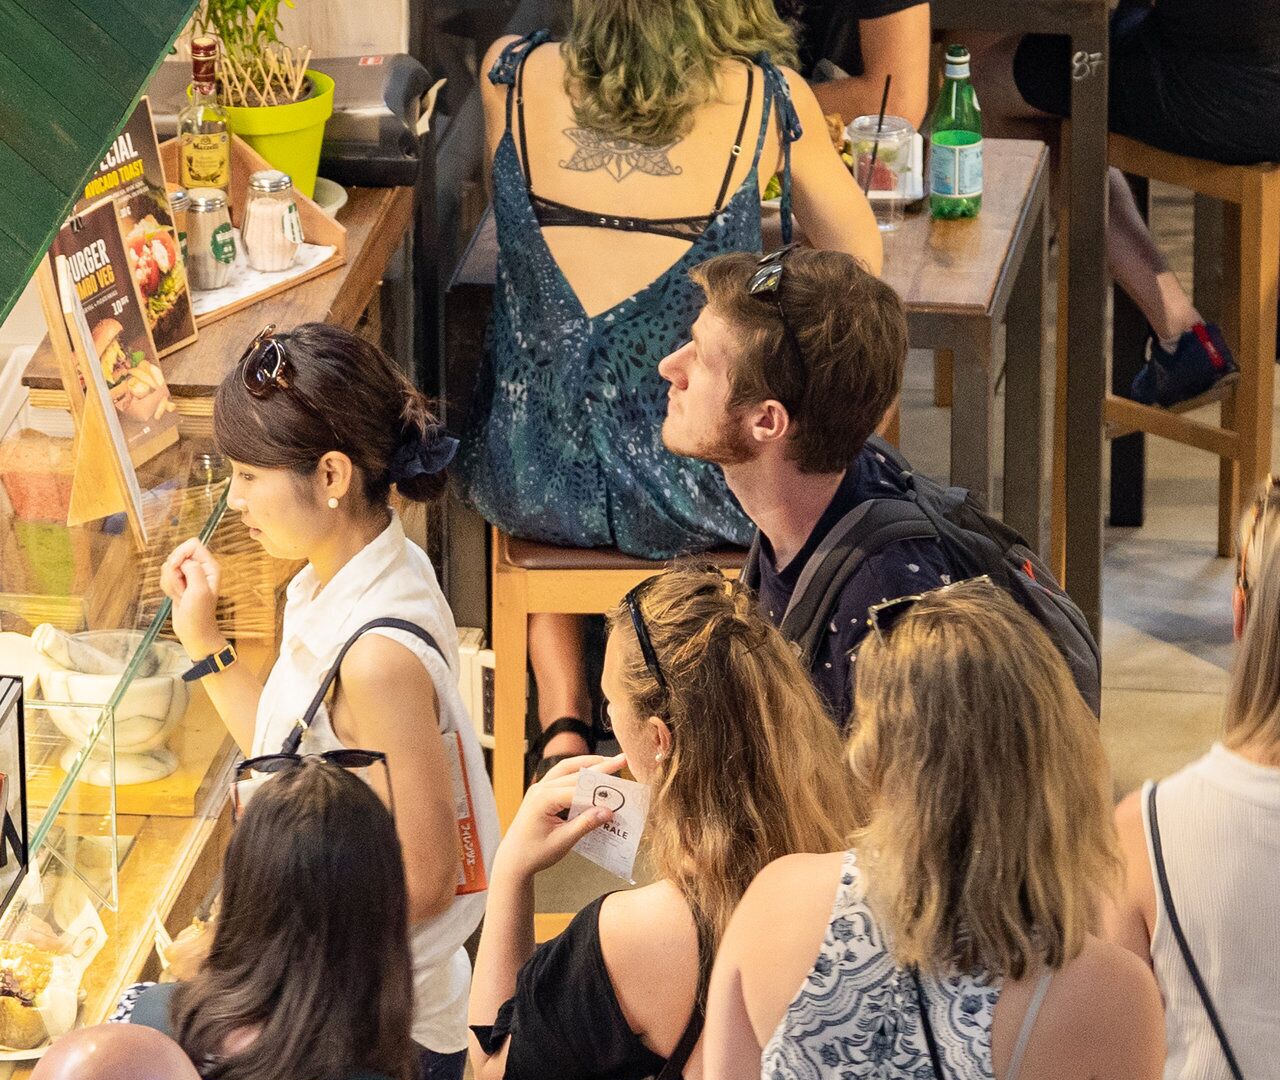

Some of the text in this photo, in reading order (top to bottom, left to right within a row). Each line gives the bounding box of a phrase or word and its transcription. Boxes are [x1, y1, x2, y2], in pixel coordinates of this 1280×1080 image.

[1071, 51, 1105, 80] 87
[94, 132, 139, 175] CIAL
[84, 170, 120, 200] AVOCADO
[118, 159, 144, 183] TOAST
[75, 264, 116, 300] MBO VEG
[602, 823, 629, 841] RALE
